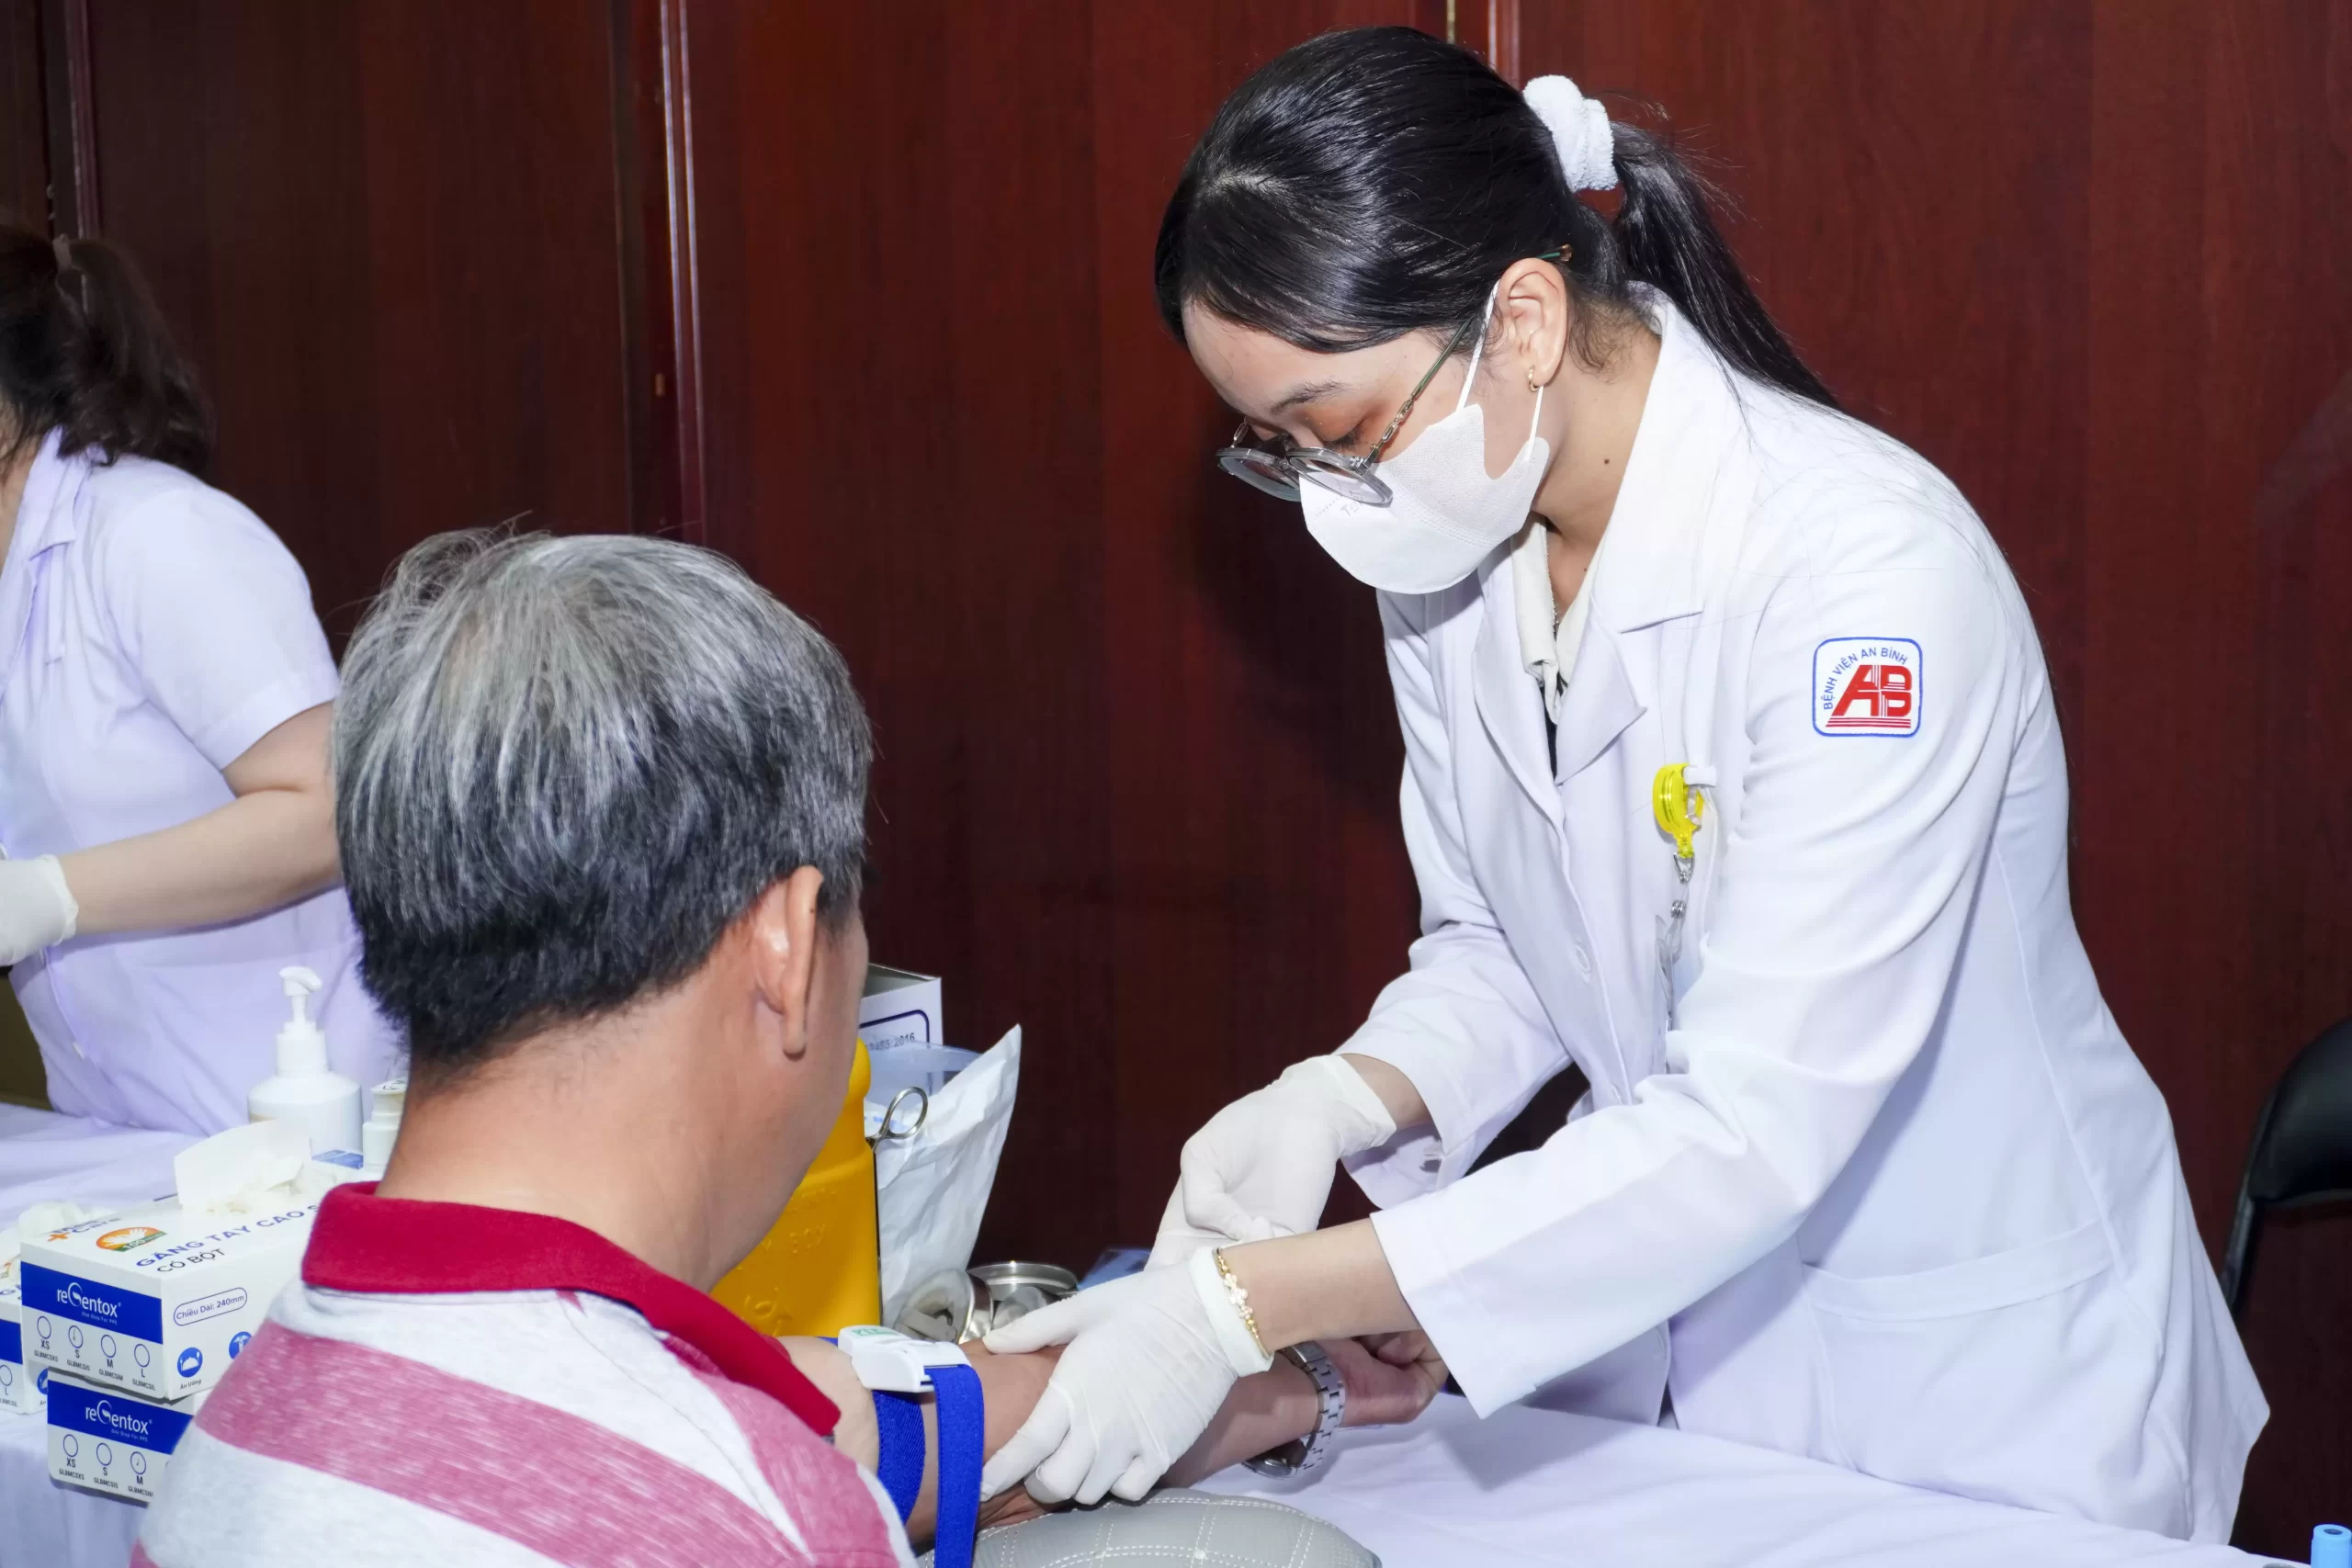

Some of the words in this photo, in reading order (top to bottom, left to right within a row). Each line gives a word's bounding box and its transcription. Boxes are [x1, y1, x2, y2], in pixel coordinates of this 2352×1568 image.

[1821, 677, 1838, 710] BỆNH
[1832, 653, 1859, 676] VIỆN
[1860, 647, 1877, 660] AN
[1880, 647, 1908, 665] BÌNH
[1831, 664, 1913, 717] AB
[136, 1241, 205, 1267] GĂNG
[207, 1225, 251, 1242] TAY
[256, 1211, 305, 1227] CAO
[157, 1259, 186, 1272] CÓ
[187, 1248, 226, 1264] BỘT
[216, 1295, 244, 1308] 240mm
[40, 1339, 51, 1350] XS
[75, 1349, 80, 1359] S
[107, 1359, 114, 1369] M
[141, 1368, 146, 1378] L
[5, 1386, 10, 1396] L
[66, 1457, 76, 1468] XS
[103, 1467, 108, 1476] S
[136, 1475, 143, 1485] M
